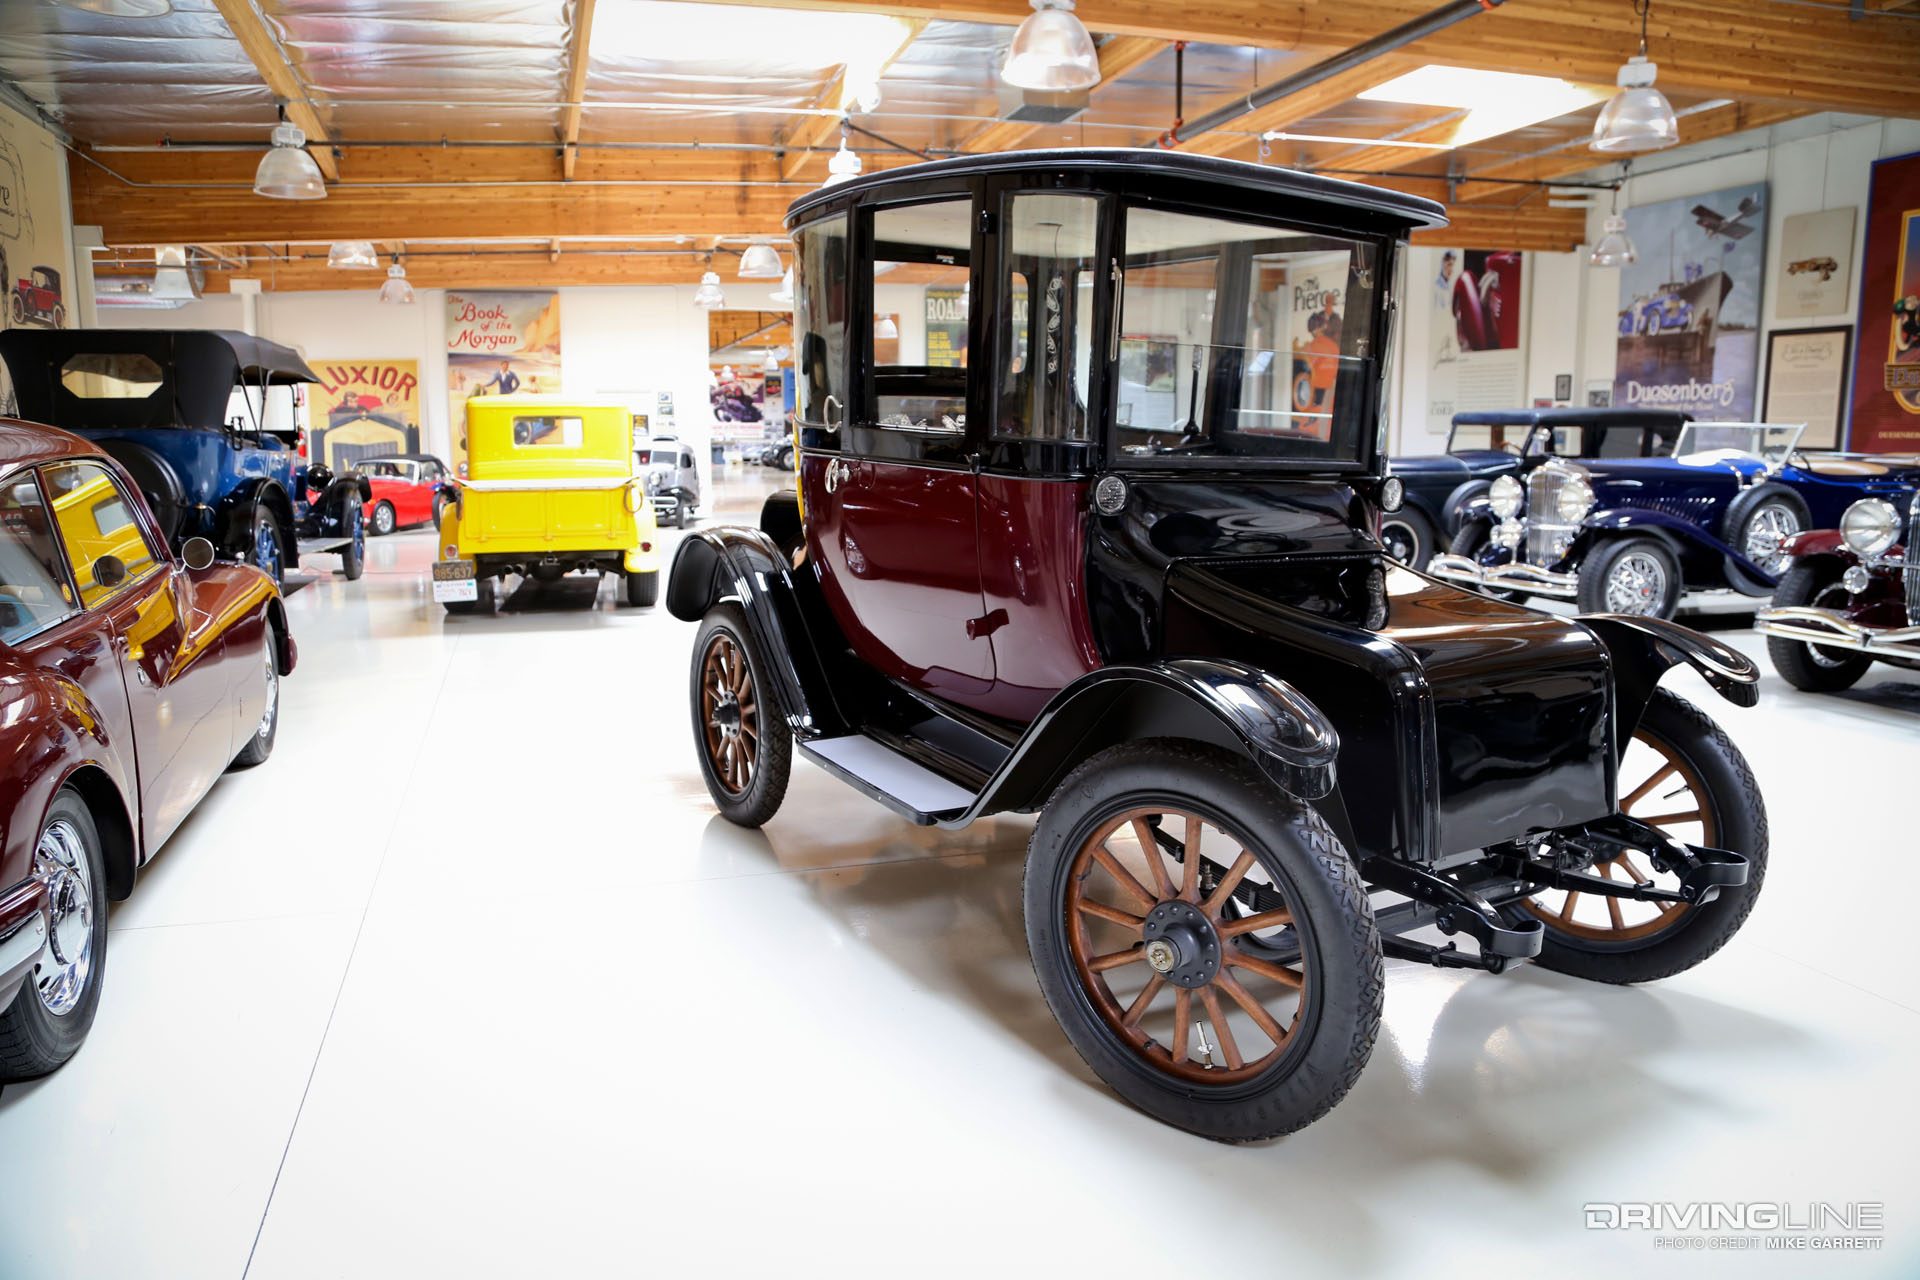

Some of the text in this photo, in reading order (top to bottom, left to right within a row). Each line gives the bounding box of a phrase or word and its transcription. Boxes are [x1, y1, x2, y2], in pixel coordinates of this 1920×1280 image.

[454, 302, 509, 322] Book
[480, 320, 512, 331] of the
[447, 329, 517, 351] Morgan
[320, 366, 417, 401] LUXIOR
[1626, 377, 1736, 407] Duesenberg
